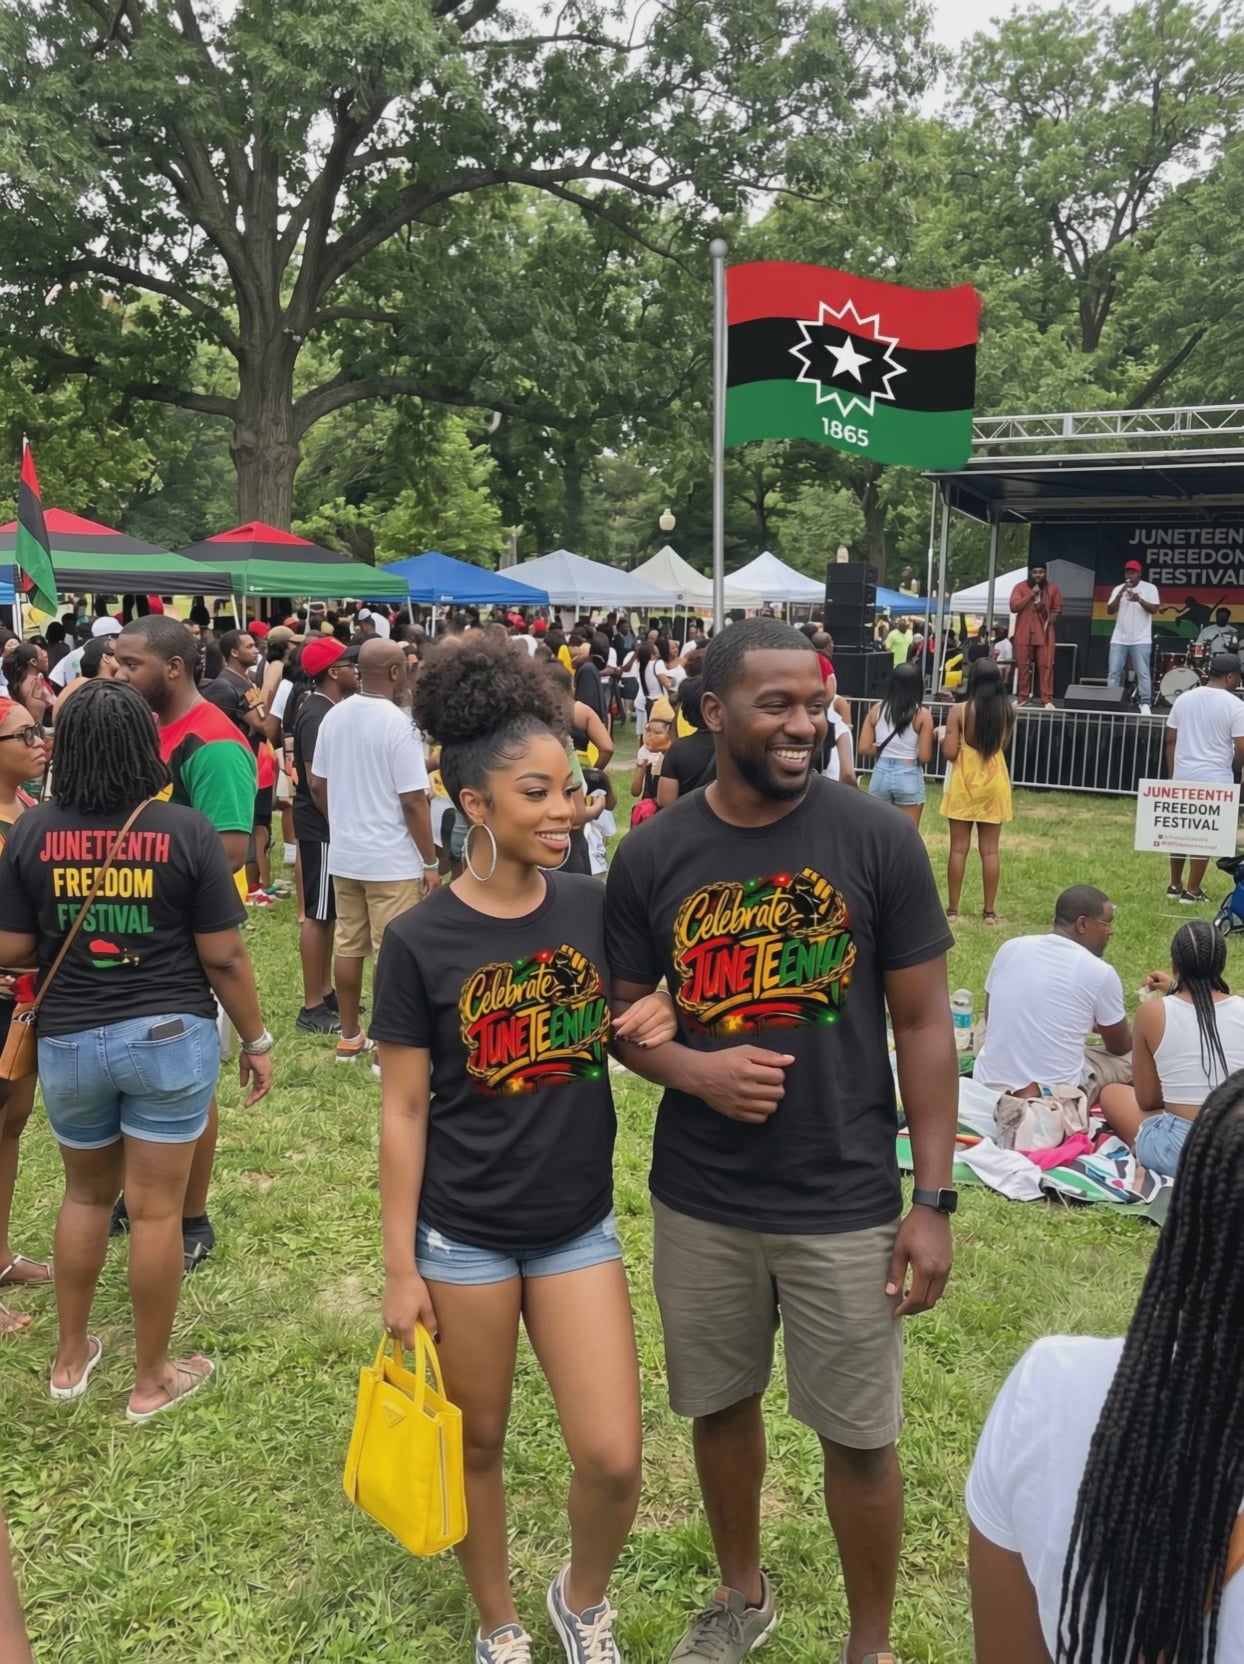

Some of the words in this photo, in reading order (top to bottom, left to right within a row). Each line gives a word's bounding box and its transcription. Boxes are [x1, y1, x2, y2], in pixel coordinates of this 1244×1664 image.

[821, 416, 869, 447] 1865
[1143, 786, 1234, 803] JUNETEENTH
[1153, 801, 1221, 816] FREEDOM
[1153, 816, 1219, 831] FESTIVAL
[680, 887, 798, 948] Celebrate
[465, 963, 558, 1022] Celebrate
